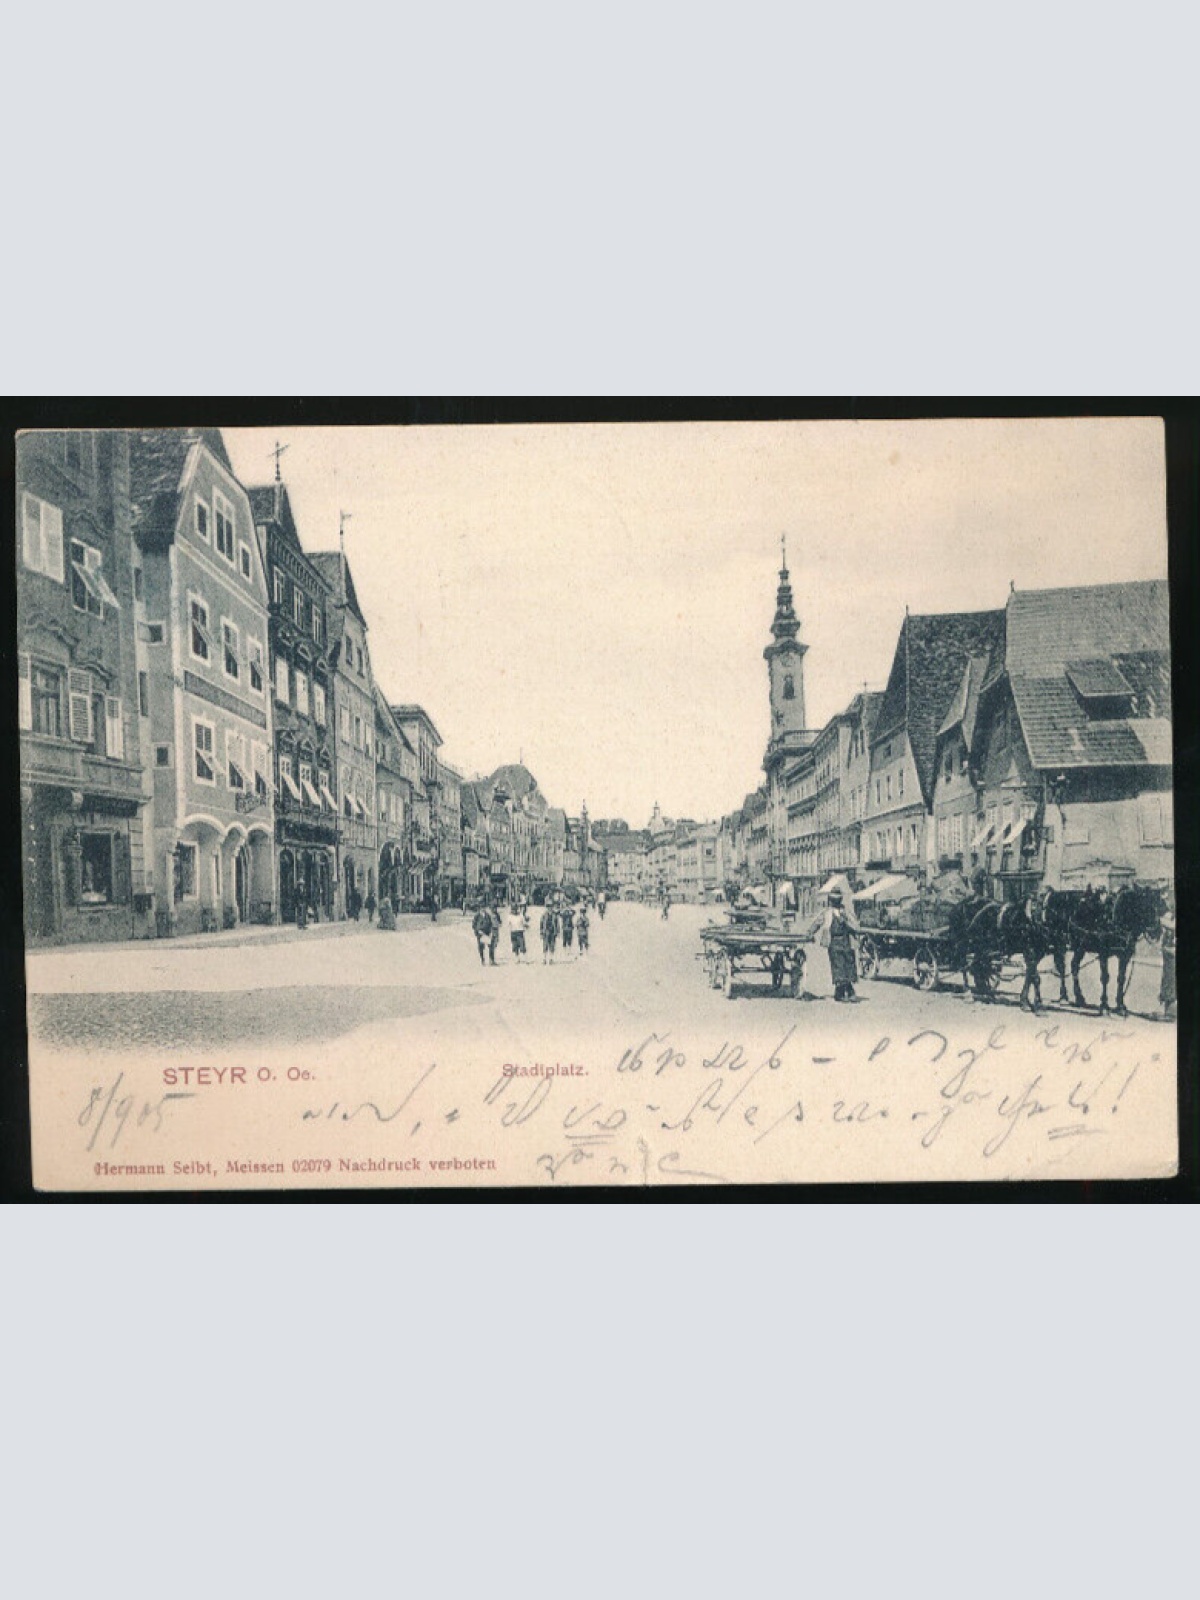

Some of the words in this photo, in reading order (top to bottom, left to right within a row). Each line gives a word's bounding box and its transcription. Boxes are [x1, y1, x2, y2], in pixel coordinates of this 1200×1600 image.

[162, 1066, 247, 1085] STEYR
[256, 1066, 277, 1082] O.
[286, 1066, 316, 1081] Oe.
[502, 1062, 589, 1080] Stadtplatz.
[94, 1161, 165, 1176] Hermann
[173, 1160, 218, 1177] Seibt,
[226, 1160, 284, 1174] Meissen
[291, 1158, 332, 1173] 02079
[338, 1157, 421, 1172] Nachdruck
[429, 1156, 496, 1171] verboten
